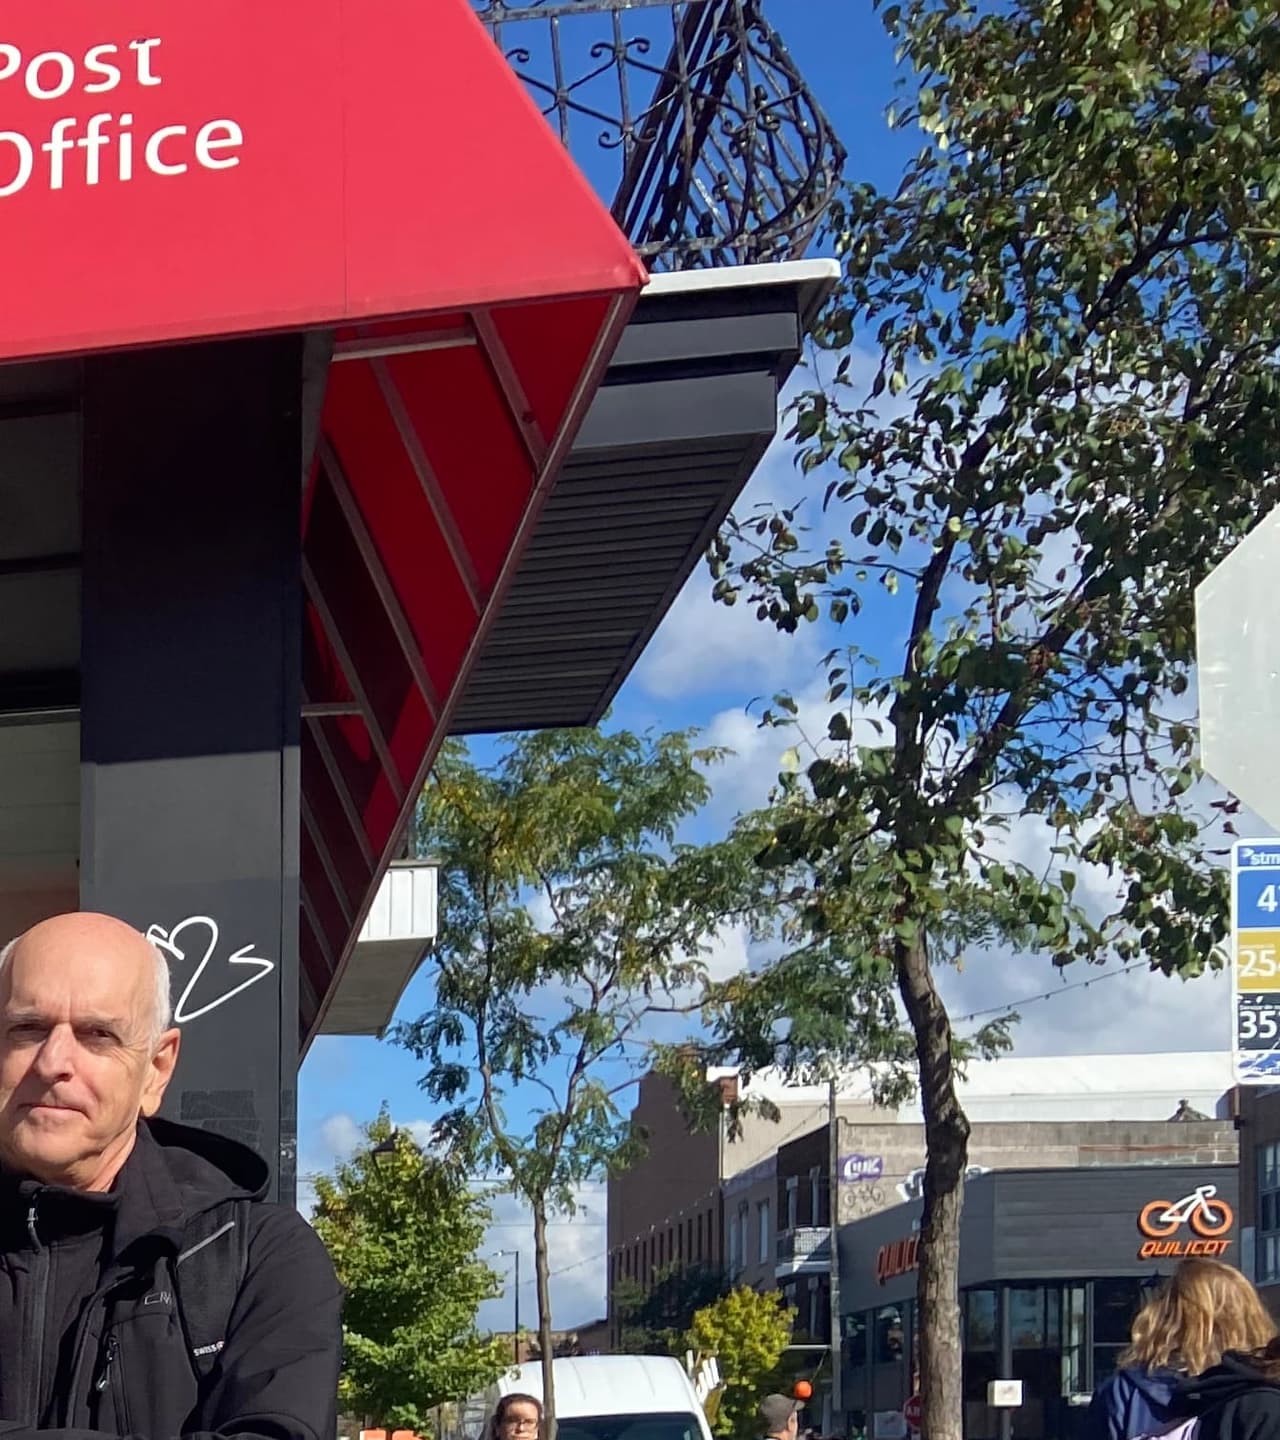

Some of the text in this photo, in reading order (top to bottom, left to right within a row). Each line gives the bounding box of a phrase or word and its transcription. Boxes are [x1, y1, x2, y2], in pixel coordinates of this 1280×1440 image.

[1256, 884, 1280, 913] 4
[1240, 949, 1280, 978] 25
[1239, 1010, 1280, 1039] 35
[1138, 1239, 1233, 1259] QUILICOT
